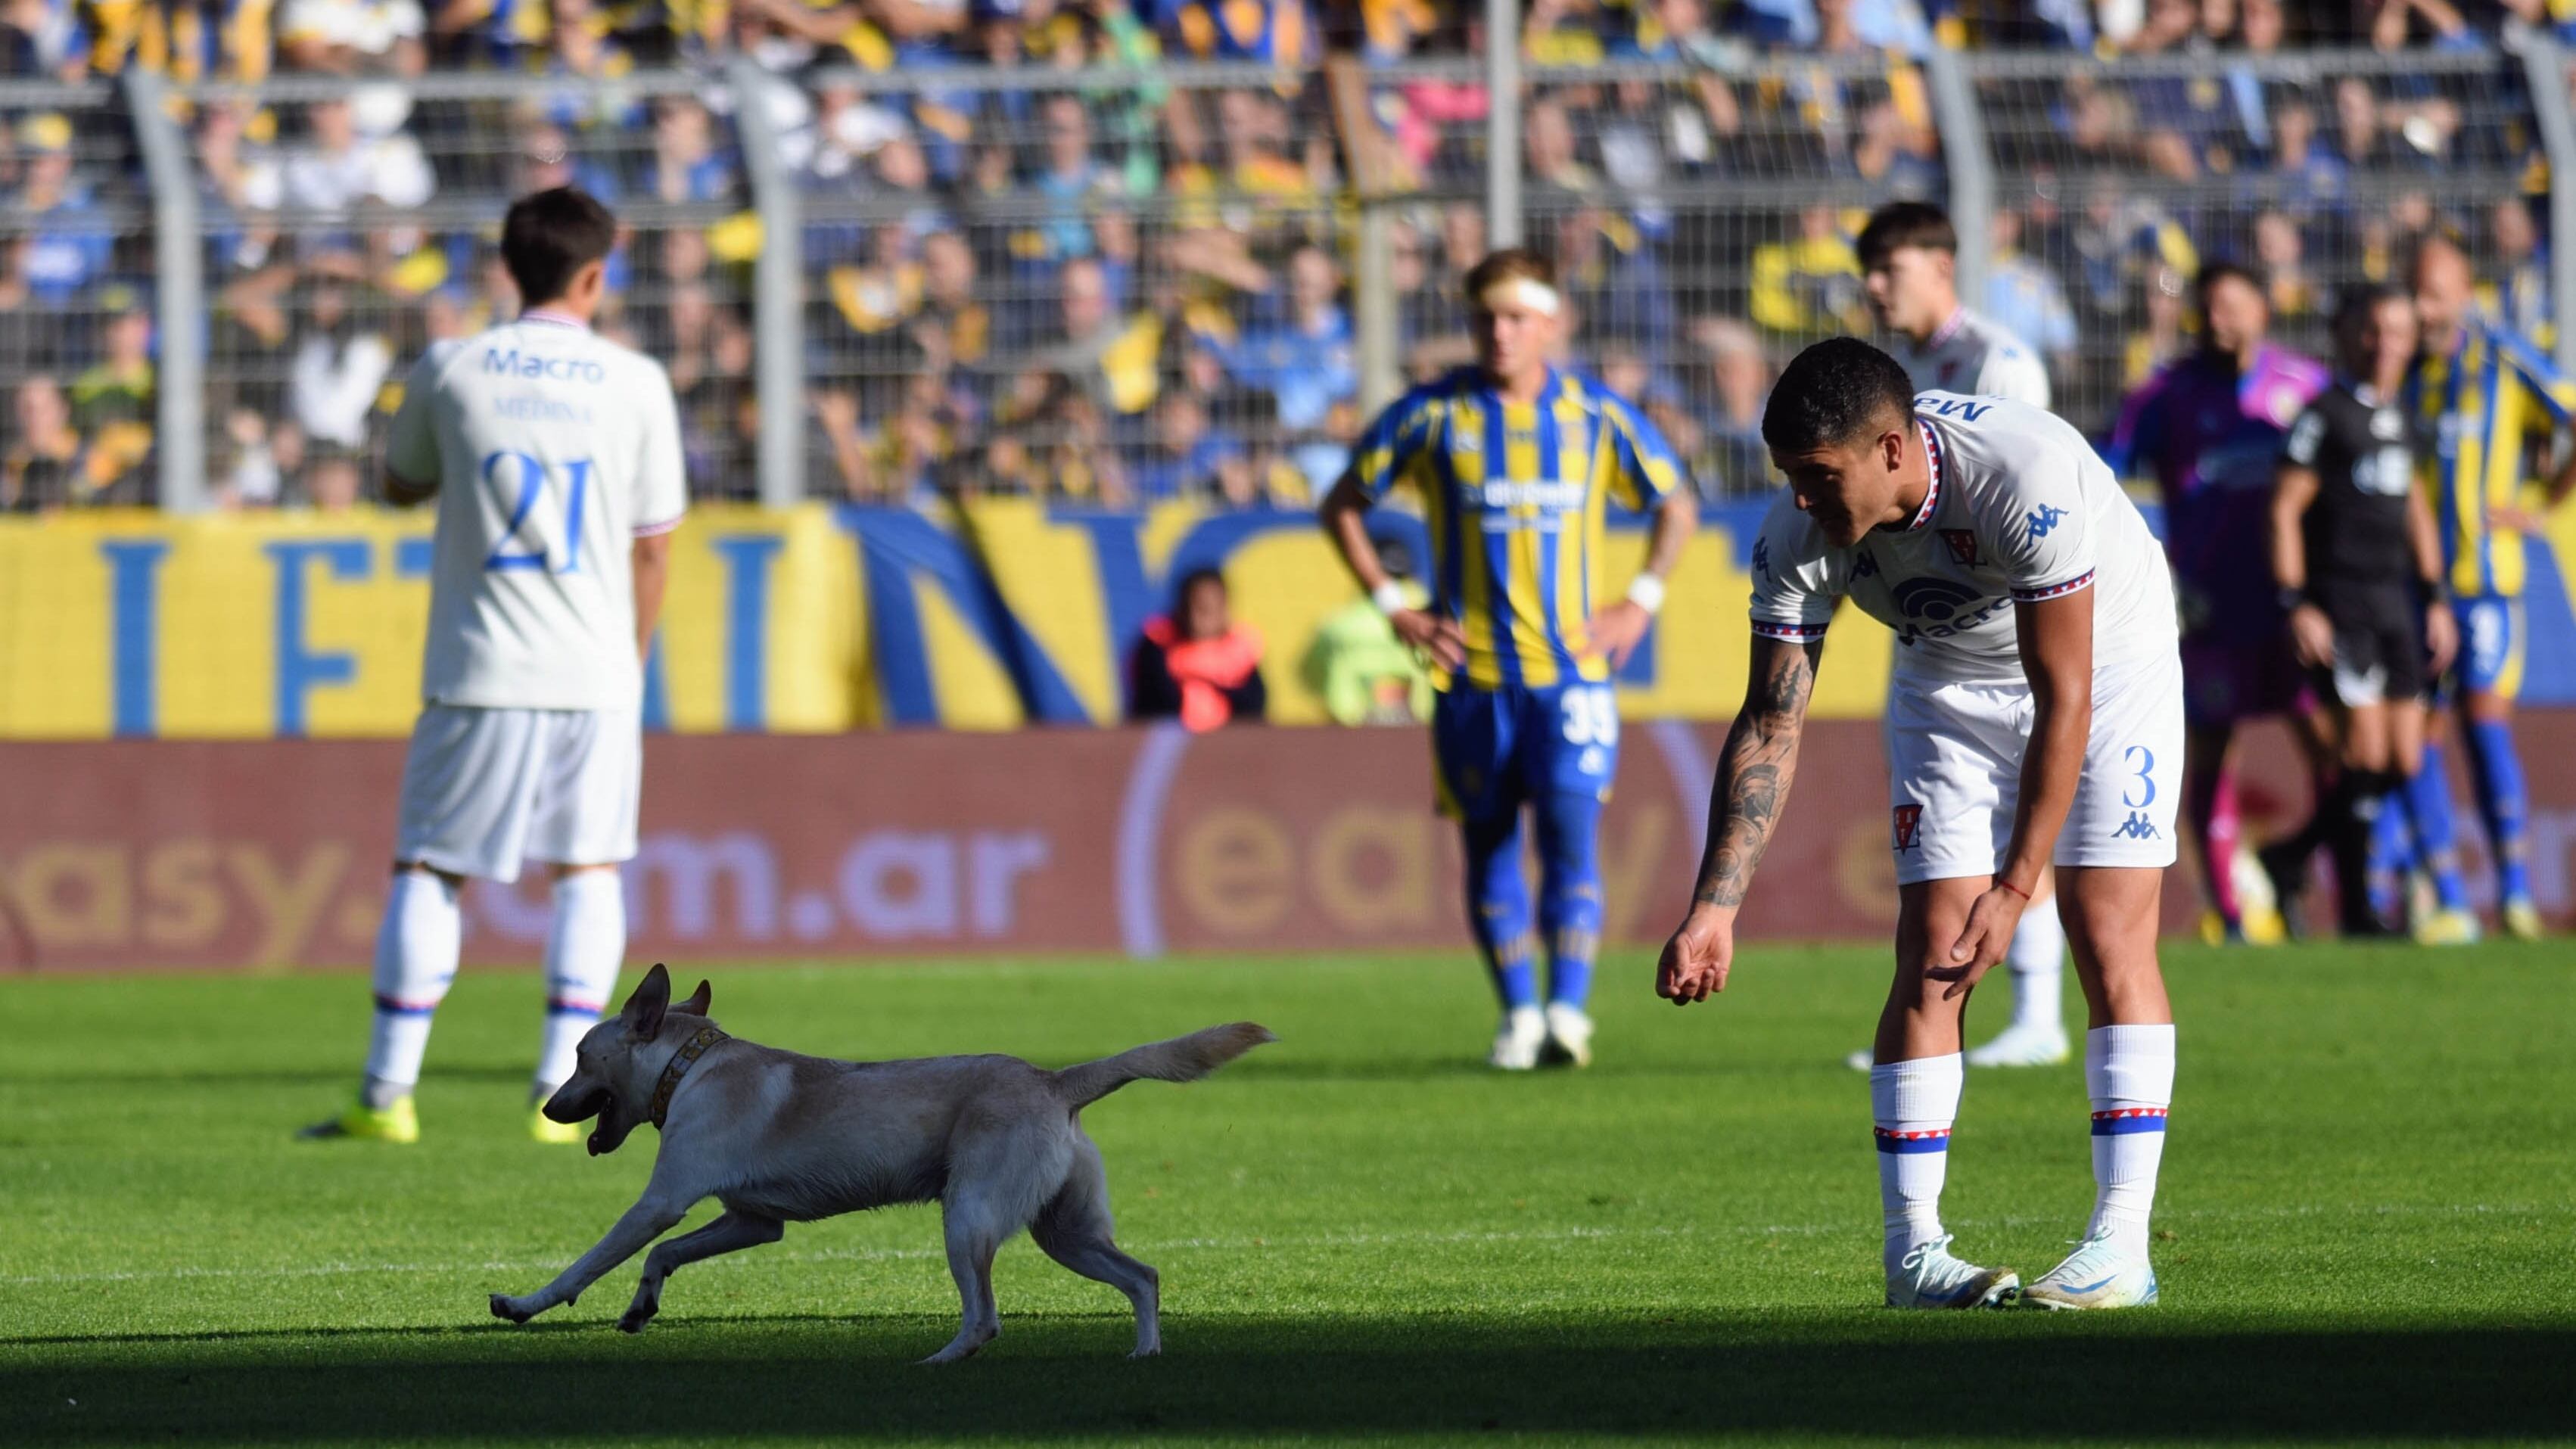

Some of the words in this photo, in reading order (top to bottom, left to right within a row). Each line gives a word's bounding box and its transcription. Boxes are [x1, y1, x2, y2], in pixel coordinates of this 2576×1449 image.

[483, 347, 607, 384] Macro
[480, 448, 593, 577] 21
[1898, 595, 2014, 648] Macro
[2122, 745, 2157, 809] 3
